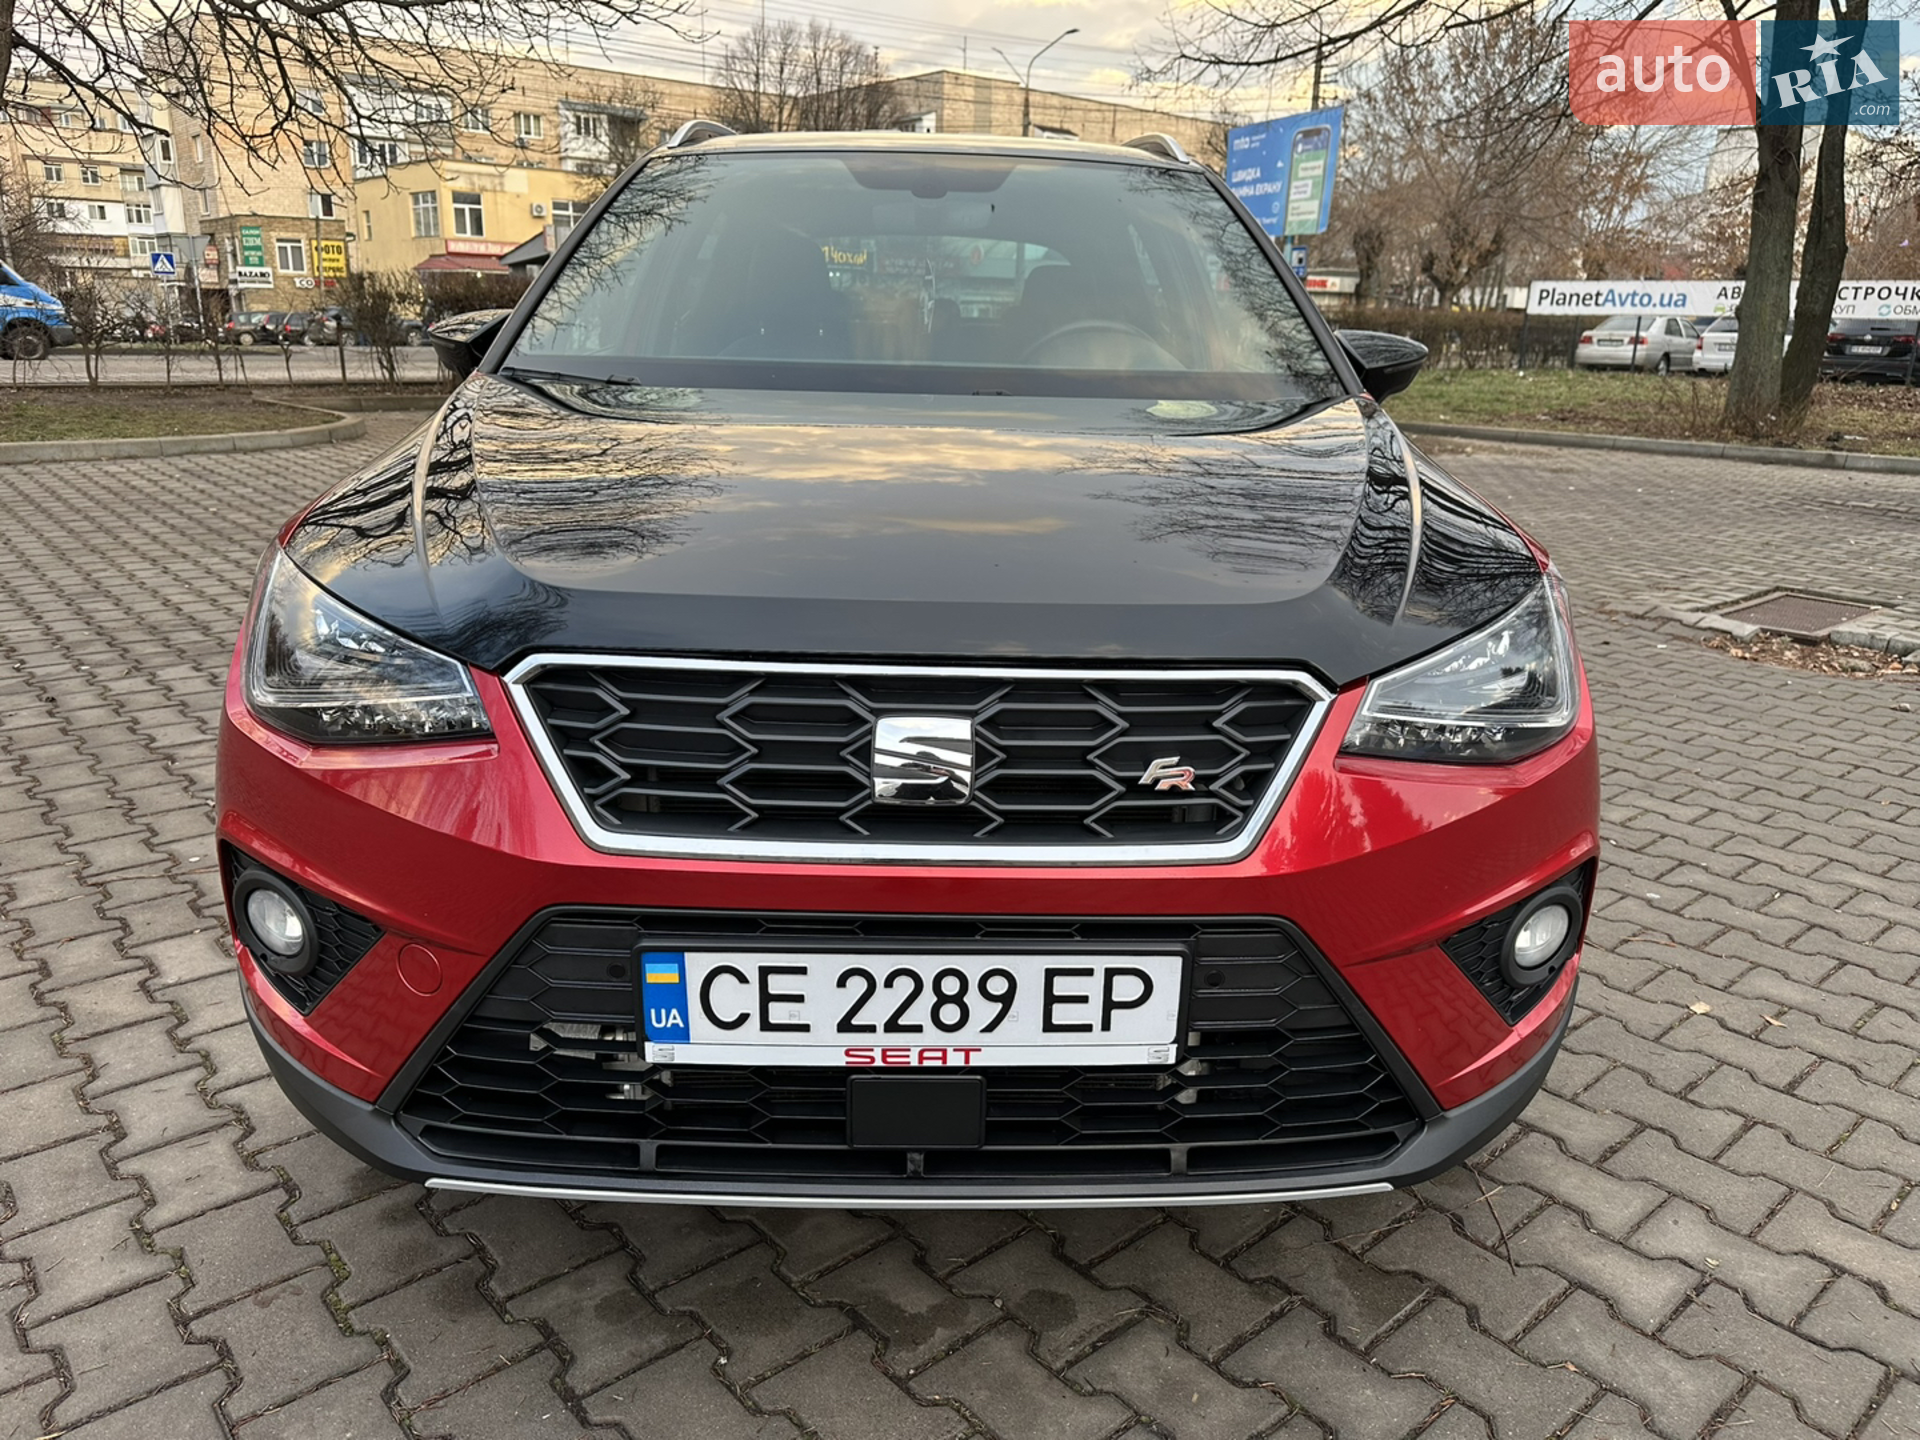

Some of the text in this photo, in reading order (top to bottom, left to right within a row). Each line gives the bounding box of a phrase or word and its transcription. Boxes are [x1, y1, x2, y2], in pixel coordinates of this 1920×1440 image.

[1537, 288, 1687, 308] PlanetAvto.ua
[1716, 286, 1920, 301] АВ СТРОЧК
[1893, 305, 1920, 316] ОБМ
[1138, 756, 1196, 791] FR
[700, 965, 1154, 1034] CE 2289 EP
[650, 1008, 684, 1028] UA
[844, 1047, 982, 1066] SEAT
